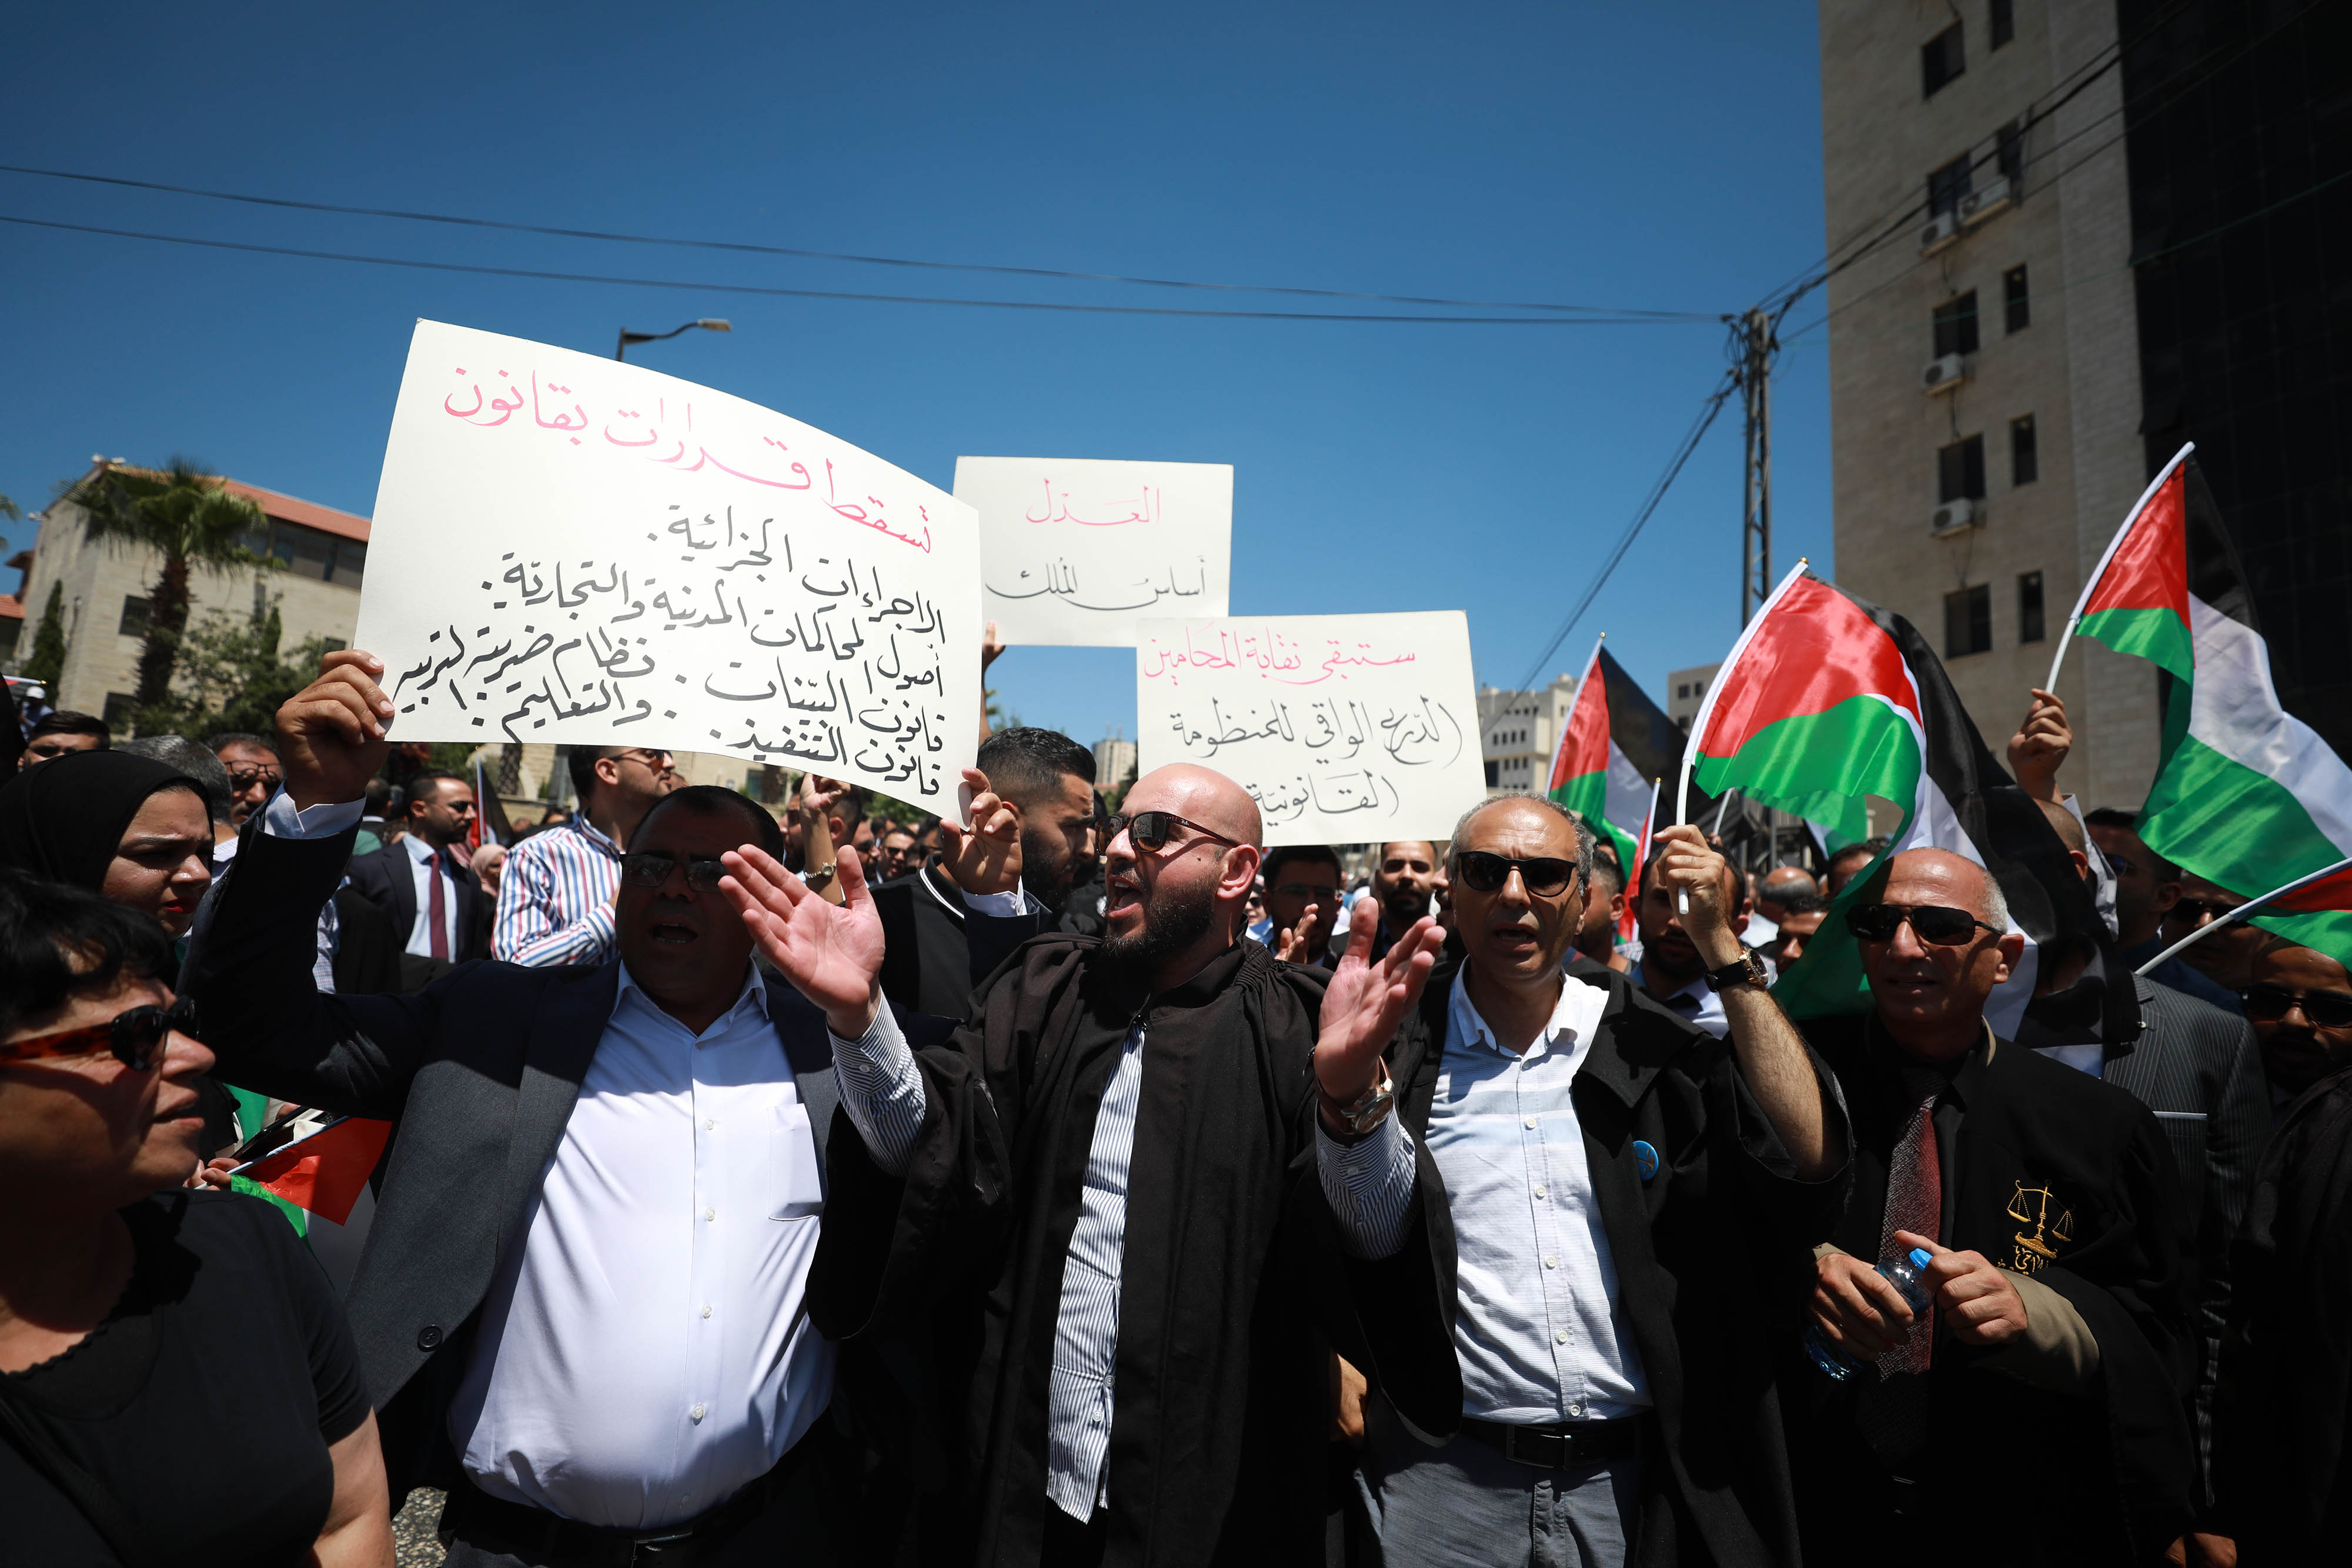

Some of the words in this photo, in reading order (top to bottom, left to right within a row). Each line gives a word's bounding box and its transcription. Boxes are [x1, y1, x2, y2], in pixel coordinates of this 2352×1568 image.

[443, 367, 589, 446] بقانون
[644, 578, 747, 631] المدنية
[553, 626, 656, 699] نظام
[1244, 626, 1302, 678] نقابة
[859, 697, 946, 752] قانون
[1305, 697, 1374, 764] الواقي
[854, 738, 941, 795] قانون
